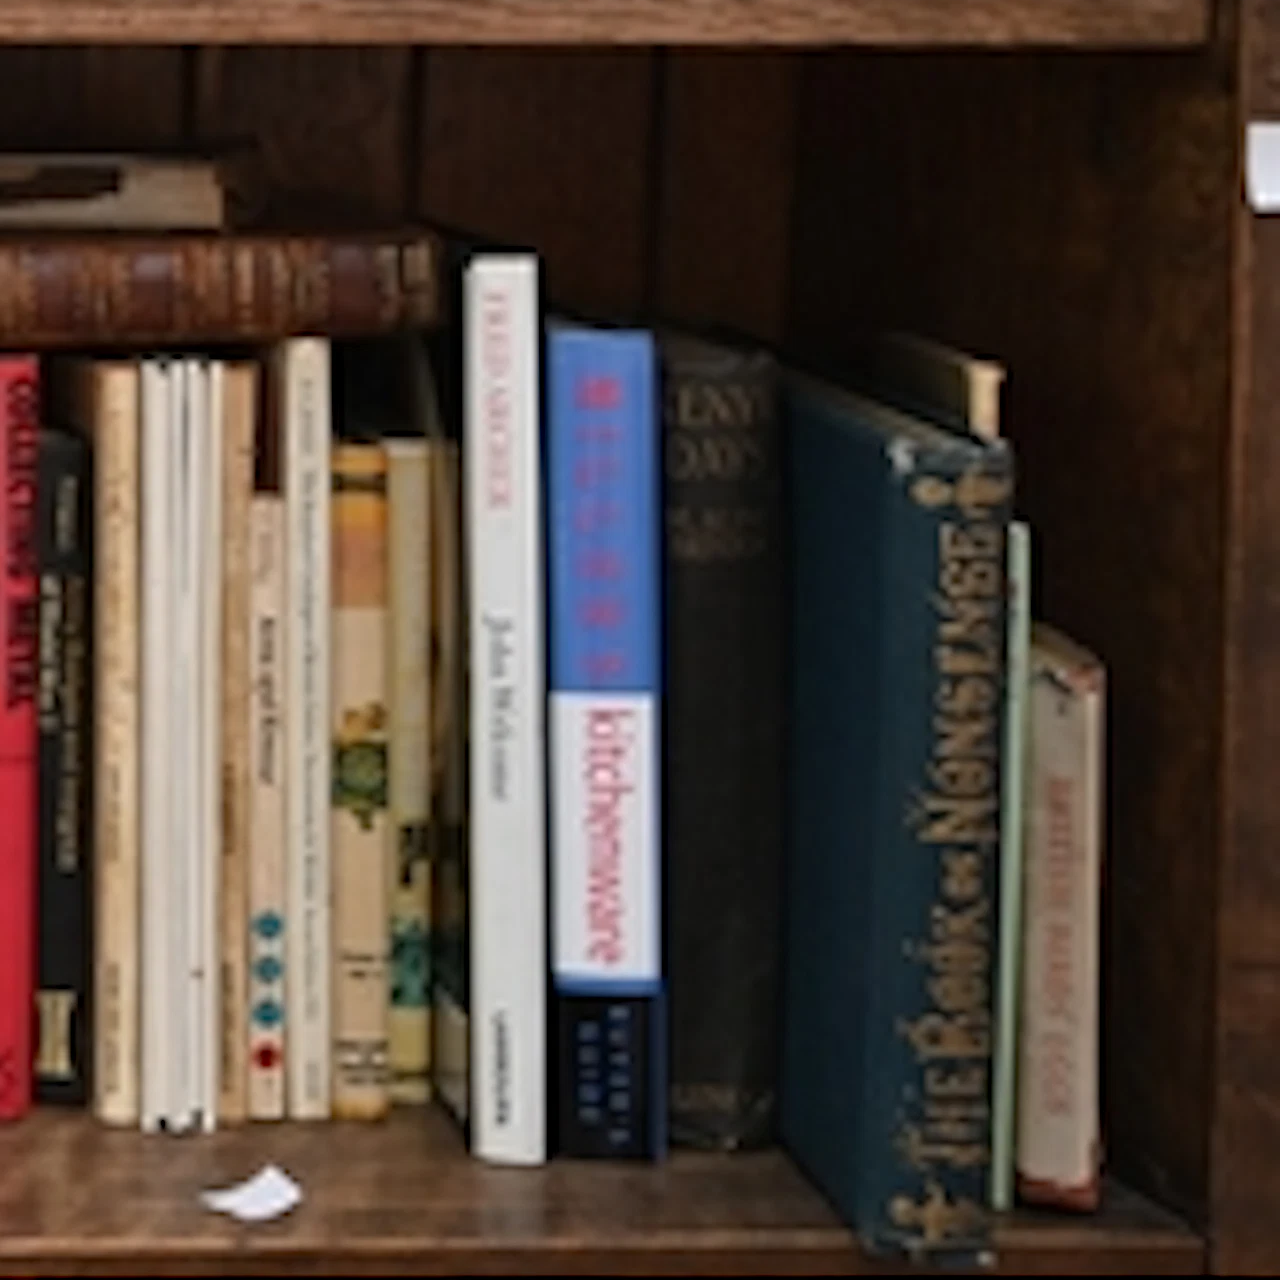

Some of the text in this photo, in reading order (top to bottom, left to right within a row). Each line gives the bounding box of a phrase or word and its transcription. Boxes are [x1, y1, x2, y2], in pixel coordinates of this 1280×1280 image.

[6, 377, 37, 713] COLLECTING METAL
[912, 520, 1002, 845] NONSENSE
[584, 706, 636, 967] kitchenware
[904, 907, 986, 1062] BOOK
[900, 1066, 980, 1170] THE
